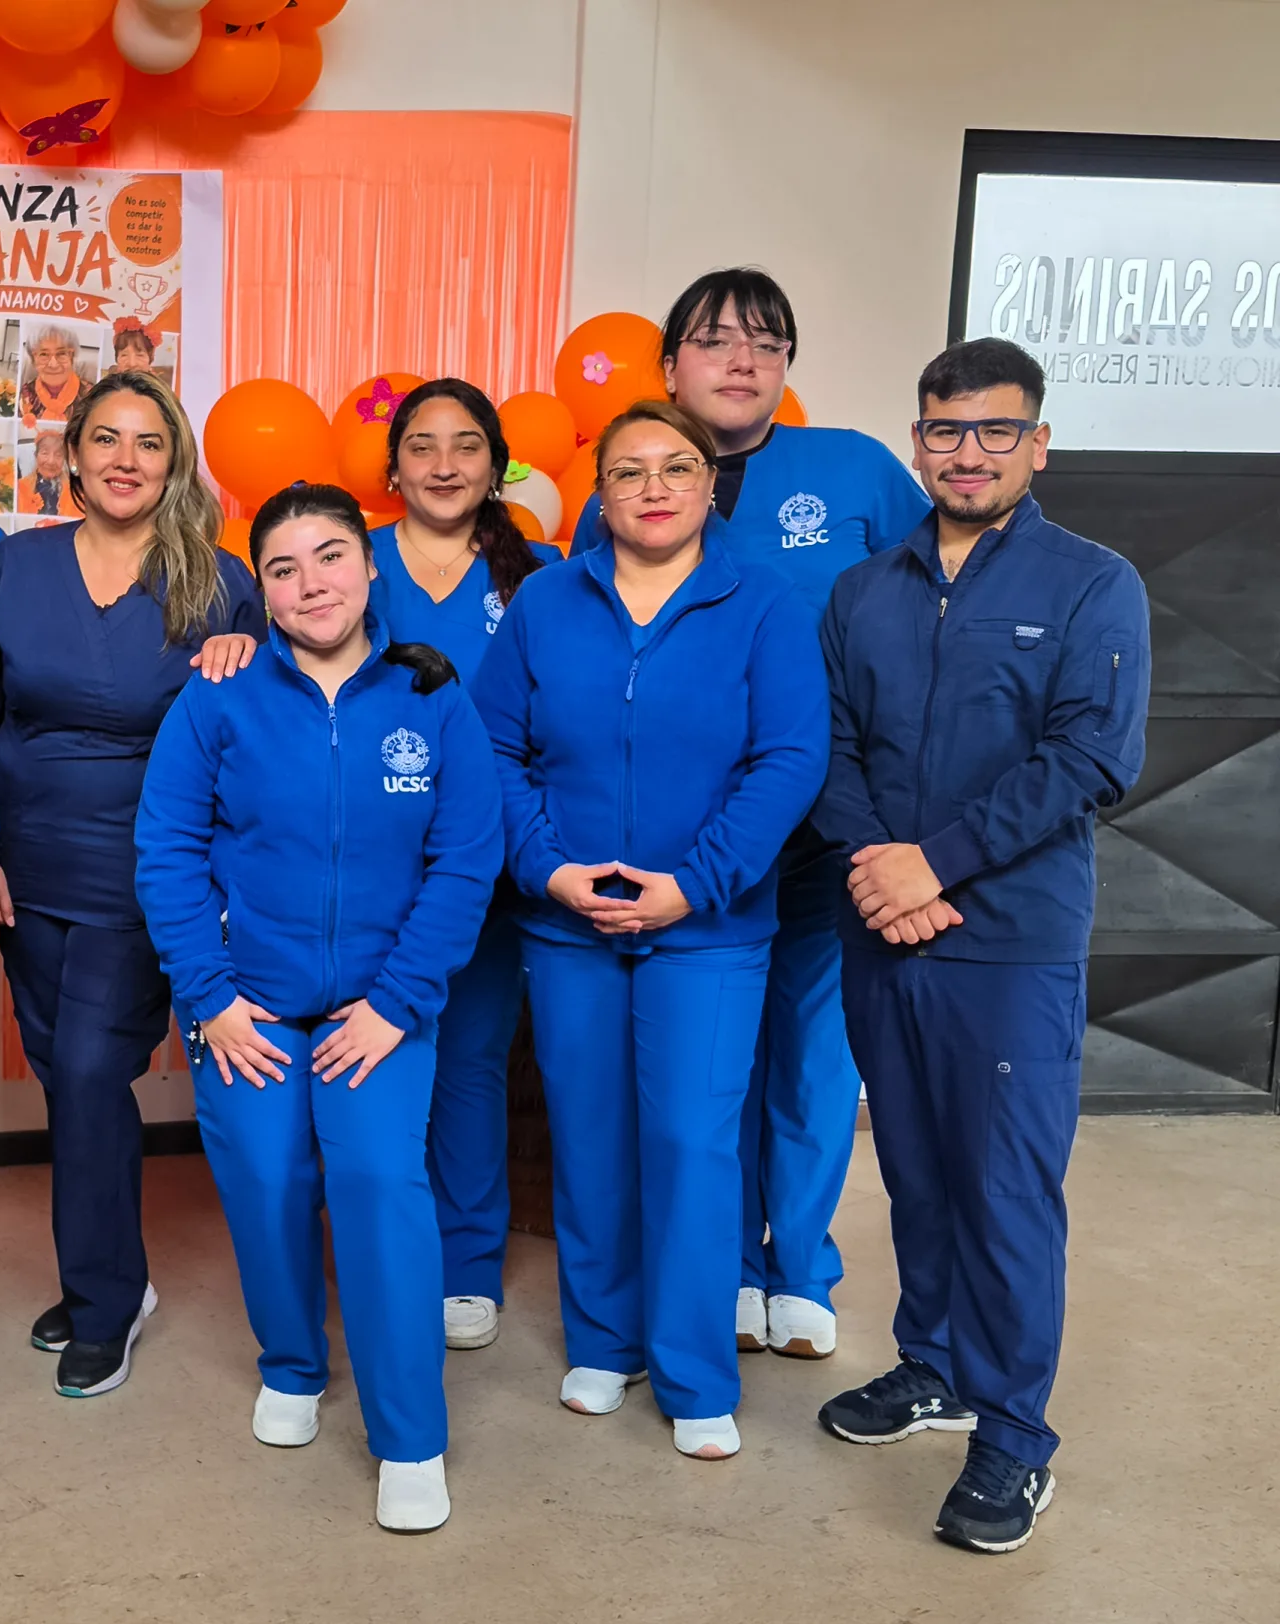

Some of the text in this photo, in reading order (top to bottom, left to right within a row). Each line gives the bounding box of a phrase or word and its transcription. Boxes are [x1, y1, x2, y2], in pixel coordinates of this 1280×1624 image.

[125, 196, 137, 206] No
[150, 199, 167, 208] solo
[138, 221, 152, 231] dar
[155, 222, 163, 232] lo
[125, 234, 162, 245] mejor de
[125, 246, 162, 256] nosotros
[782, 529, 830, 549] UCSC
[383, 776, 431, 793] UCSC
